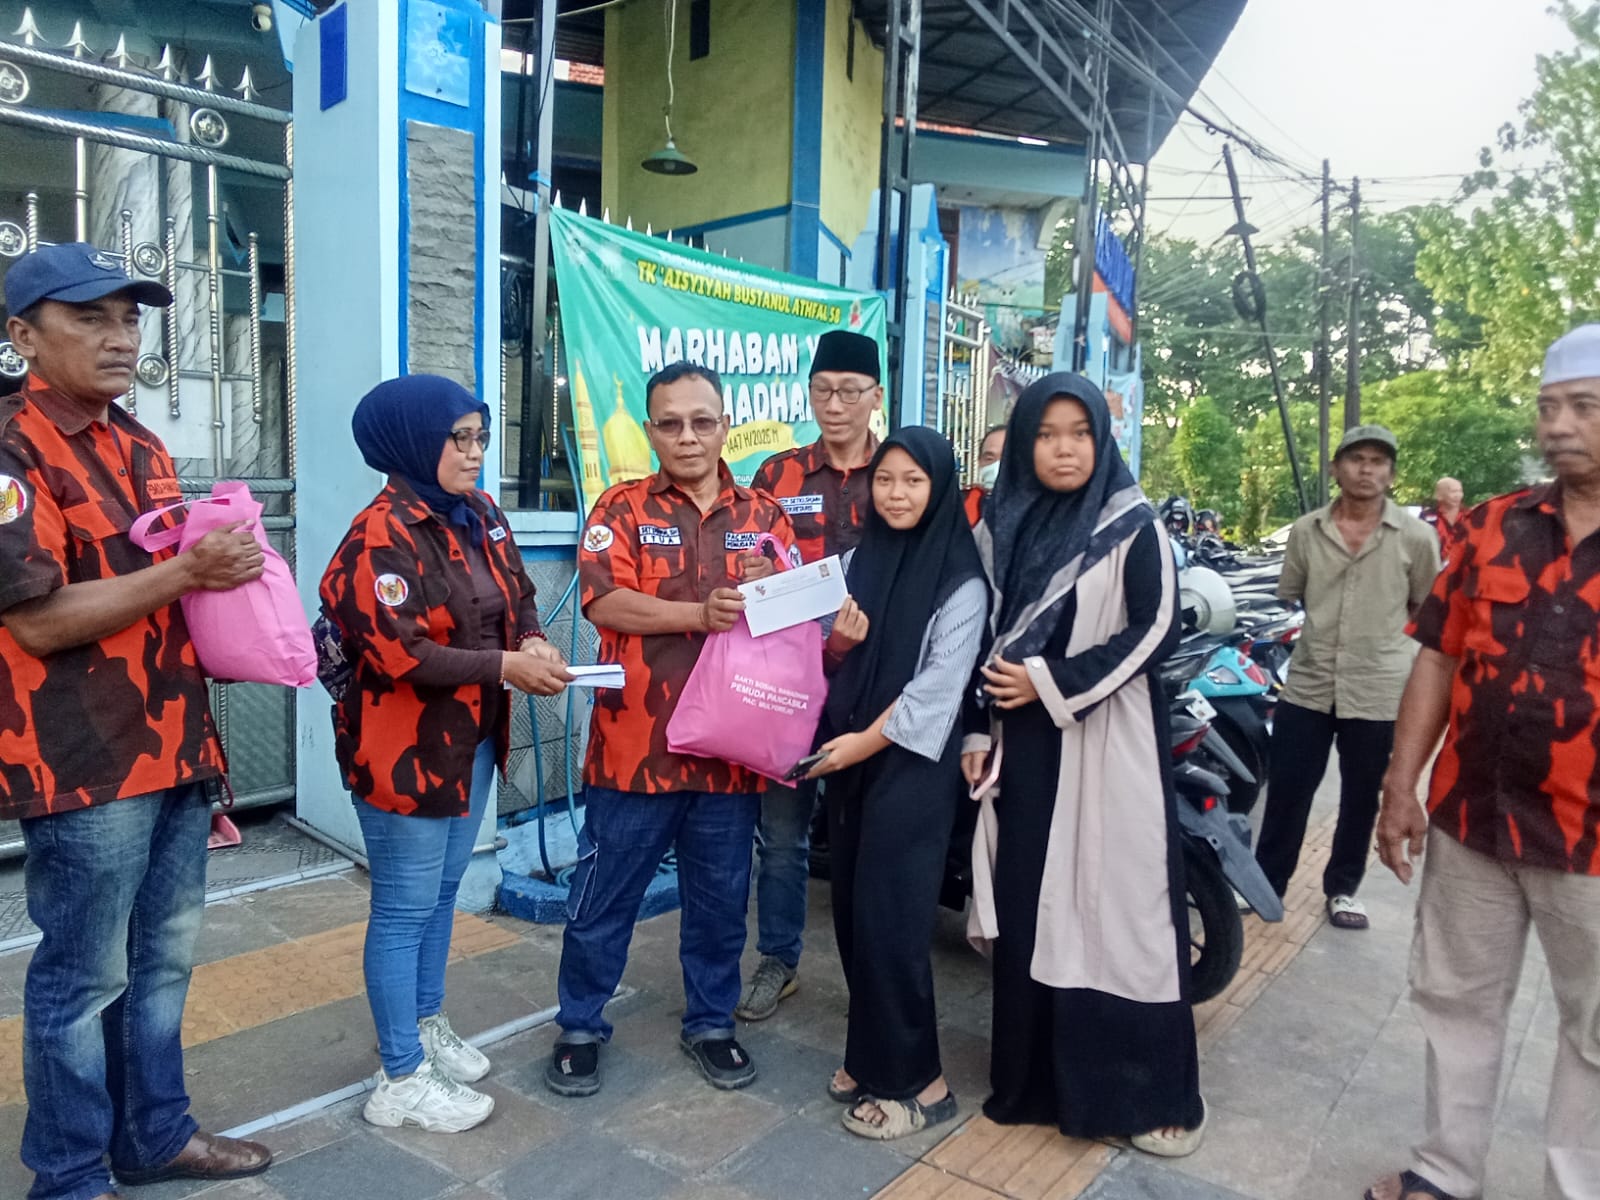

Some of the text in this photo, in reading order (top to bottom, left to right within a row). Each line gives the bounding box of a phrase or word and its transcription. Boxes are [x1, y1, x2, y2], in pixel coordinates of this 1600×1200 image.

[637, 259, 657, 285] TK
[733, 283, 790, 314] BUSTANUL
[792, 298, 828, 321] ATHFAL
[637, 325, 799, 375] MARHABAN
[730, 681, 766, 700] PEMUDA
